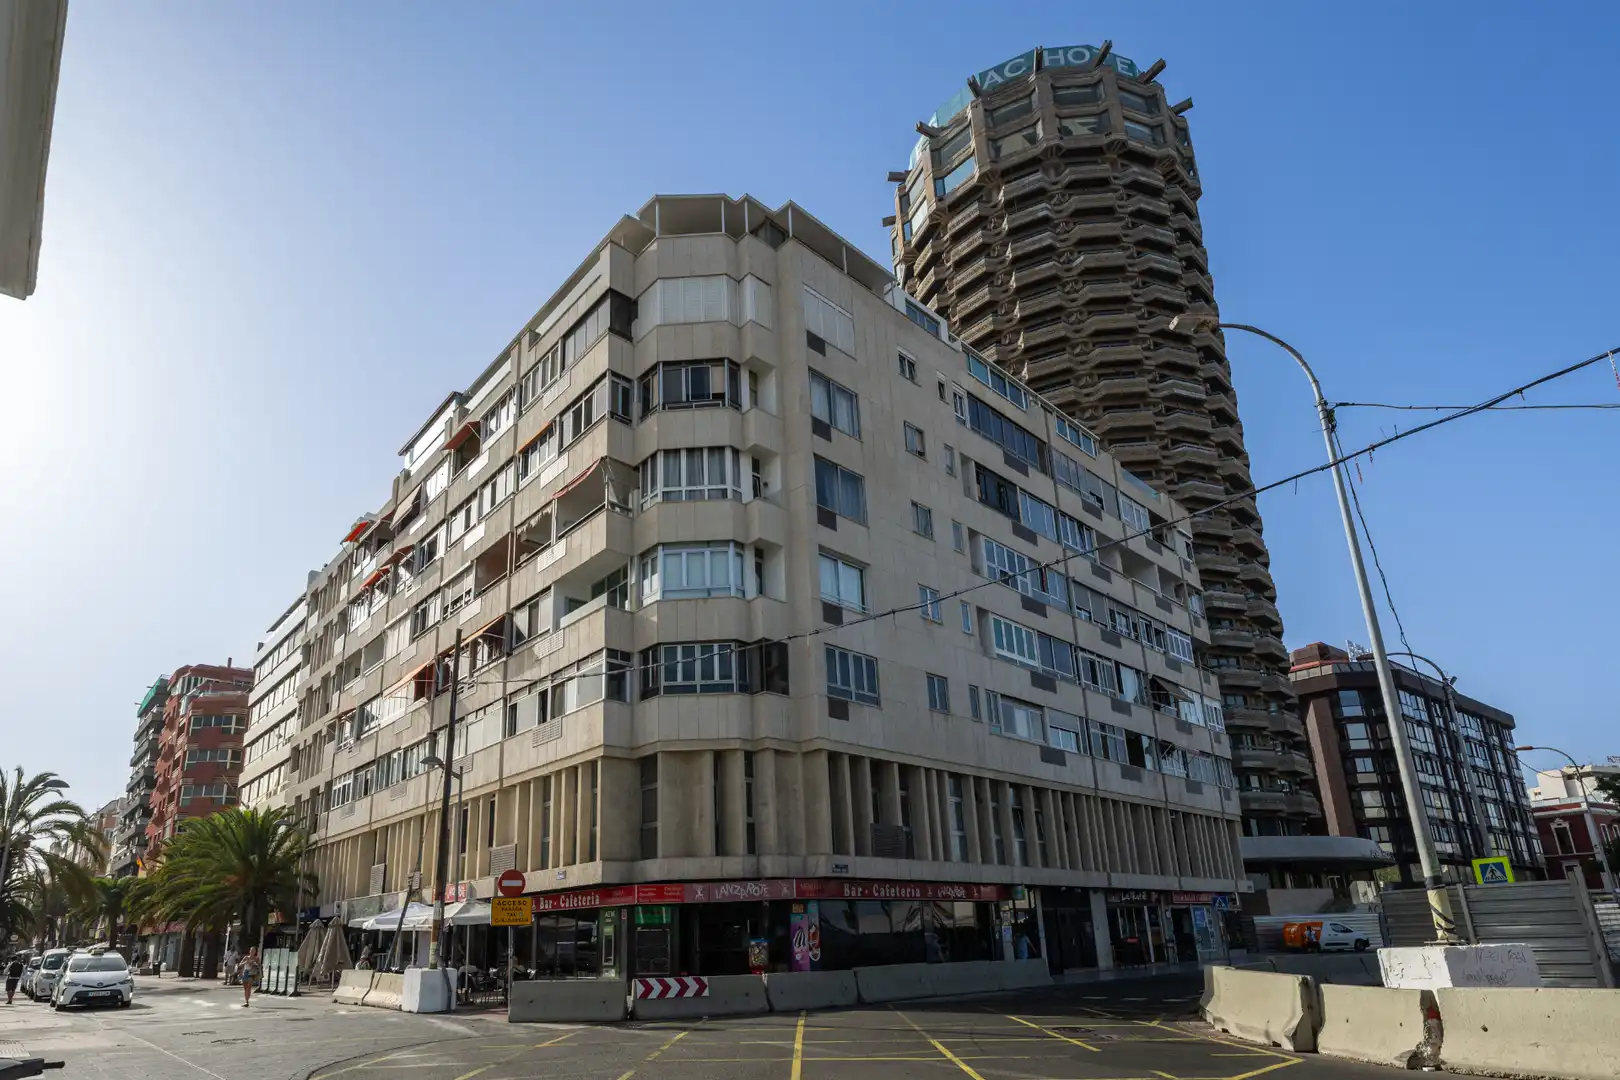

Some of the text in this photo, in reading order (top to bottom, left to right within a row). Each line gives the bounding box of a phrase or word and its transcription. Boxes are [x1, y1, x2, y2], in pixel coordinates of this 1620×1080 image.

[983, 47, 1141, 90] AC HOE
[715, 881, 770, 899] LANZAROTE
[843, 883, 862, 897] Bar
[872, 883, 921, 898] Cafeteria
[539, 896, 553, 910] Bar
[559, 892, 600, 908] Cafeteria
